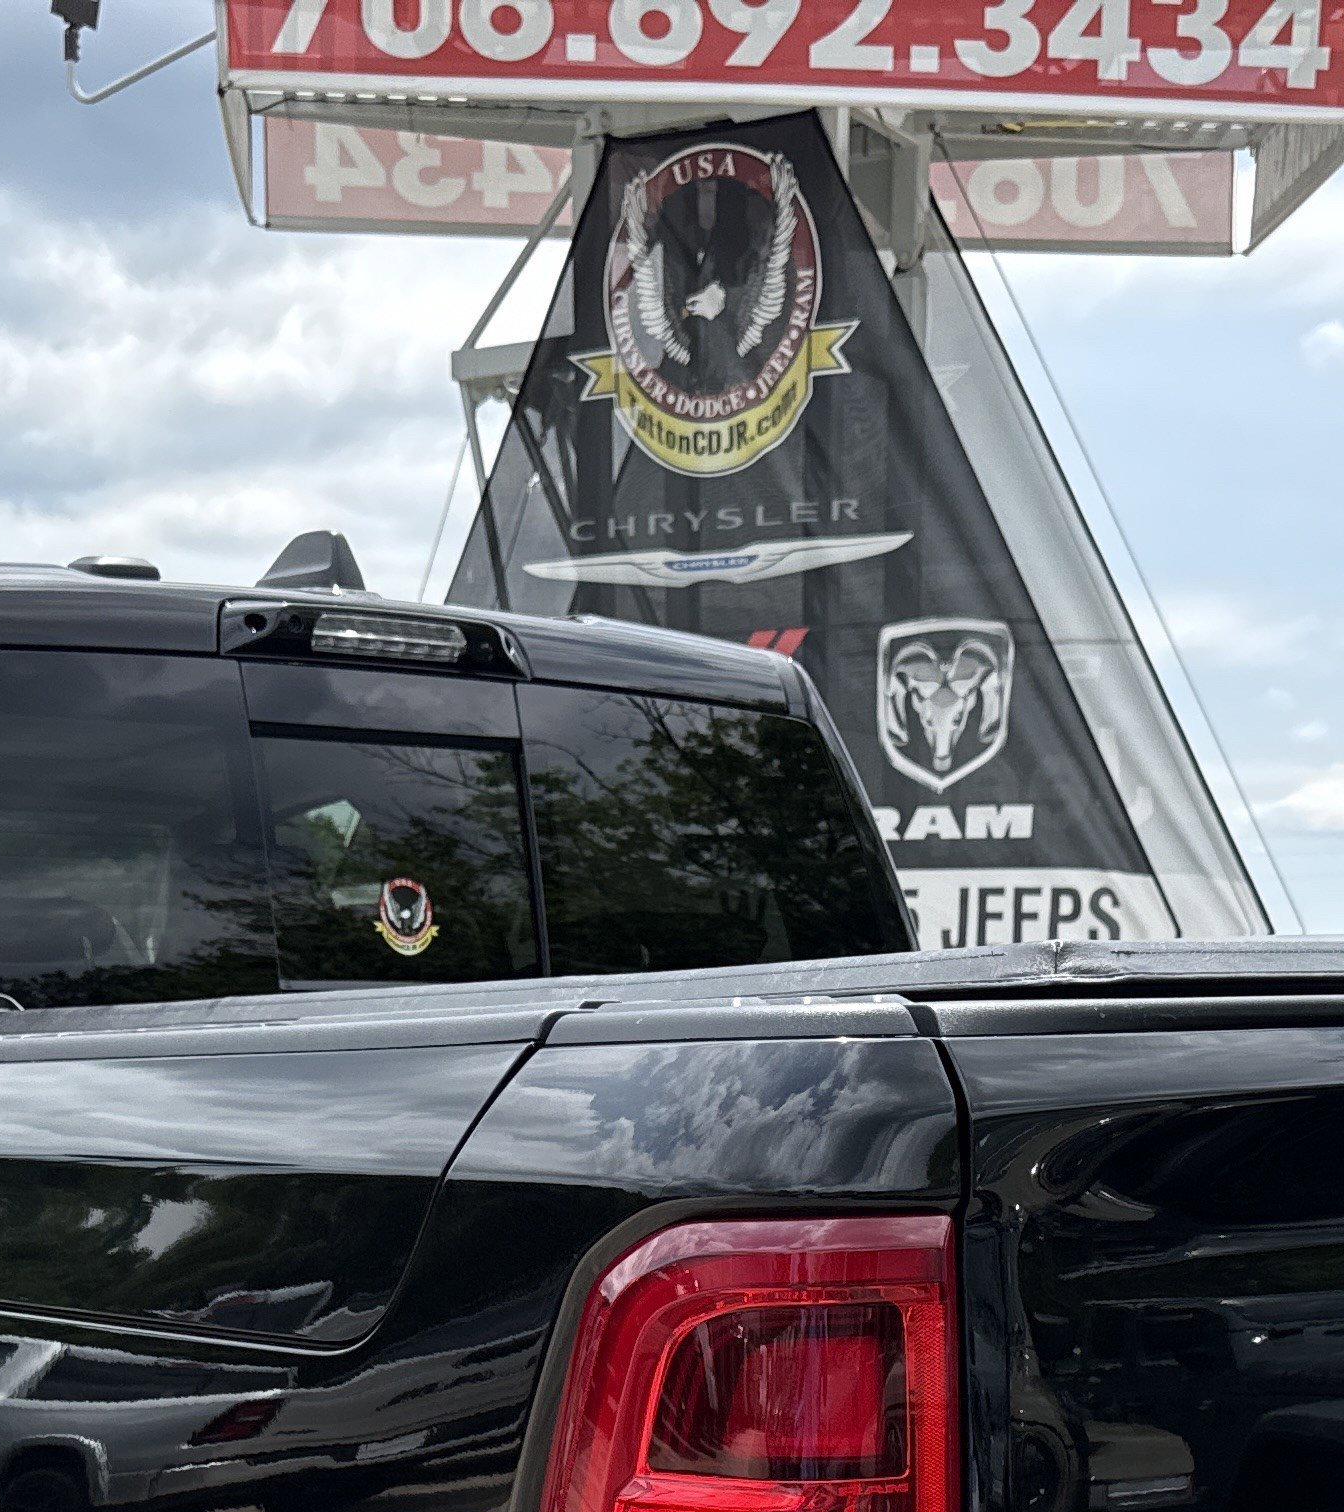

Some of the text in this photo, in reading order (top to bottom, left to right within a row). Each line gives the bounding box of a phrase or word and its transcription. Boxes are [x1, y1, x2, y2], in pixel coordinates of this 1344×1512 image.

[671, 153, 737, 186] USA
[612, 268, 815, 418] CHRYSLER DODGE JEEP RAM
[569, 499, 861, 542] CHRYSLER
[870, 803, 1035, 841] RAM
